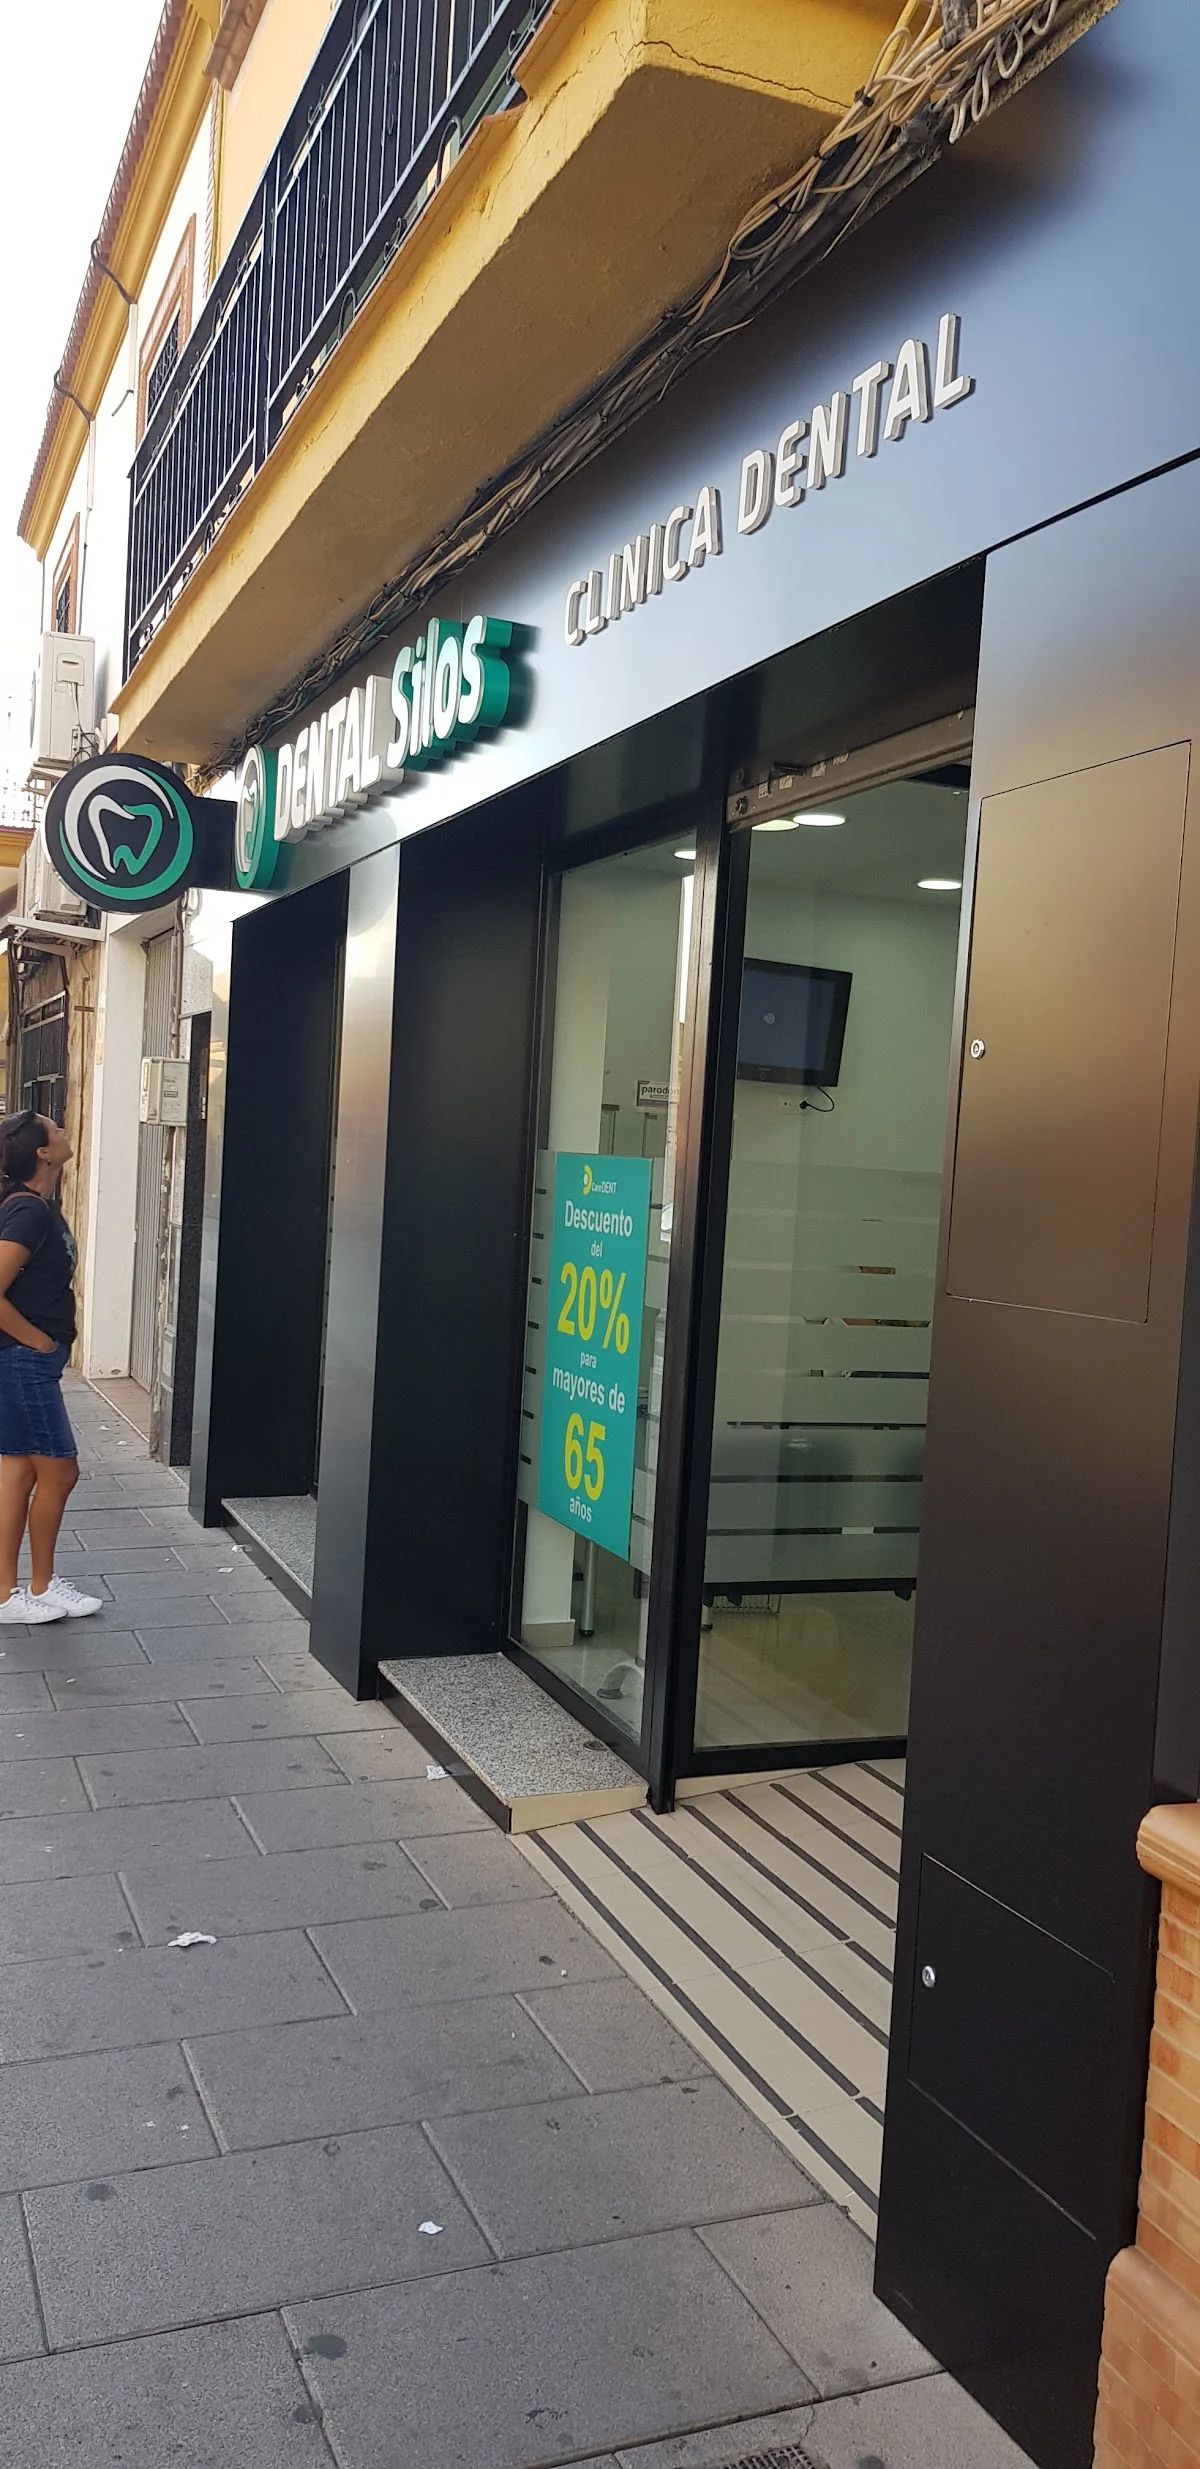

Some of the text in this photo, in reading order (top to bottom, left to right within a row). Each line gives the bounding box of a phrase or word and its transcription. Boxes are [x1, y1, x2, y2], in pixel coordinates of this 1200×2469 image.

[564, 312, 976, 646] CLINICA DENTAL
[274, 615, 512, 843] DENTAL Silos
[564, 1200, 633, 1237] Descuento
[590, 1240, 603, 1257] del
[557, 1262, 629, 1354] 20%
[580, 1352, 597, 1368] para
[552, 1367, 625, 1414] mayores de
[564, 1412, 606, 1501] 65
[569, 1495, 592, 1523] años
